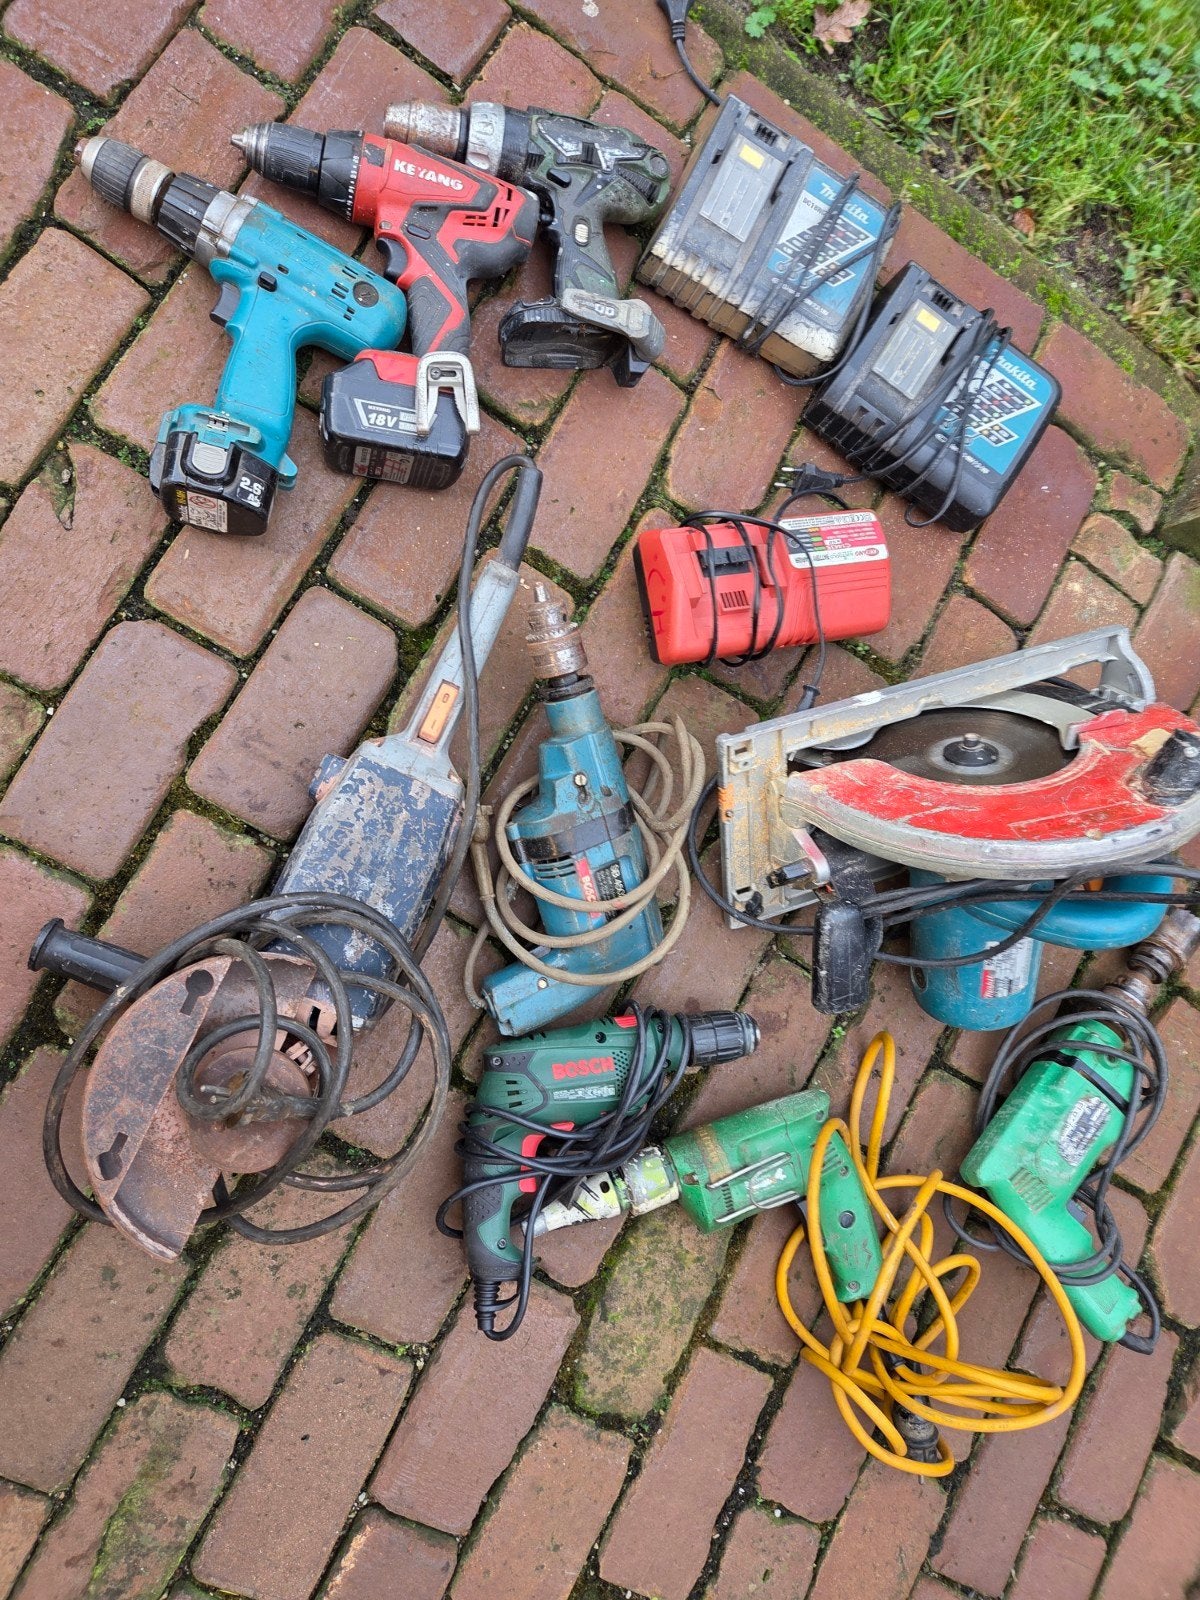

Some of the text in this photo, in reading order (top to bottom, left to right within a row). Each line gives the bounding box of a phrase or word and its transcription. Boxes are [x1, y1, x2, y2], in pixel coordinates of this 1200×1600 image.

[394, 158, 464, 191] KEYANG
[819, 182, 870, 225] Mita
[368, 412, 399, 428] 18V
[551, 1056, 615, 1081] BOSCH
